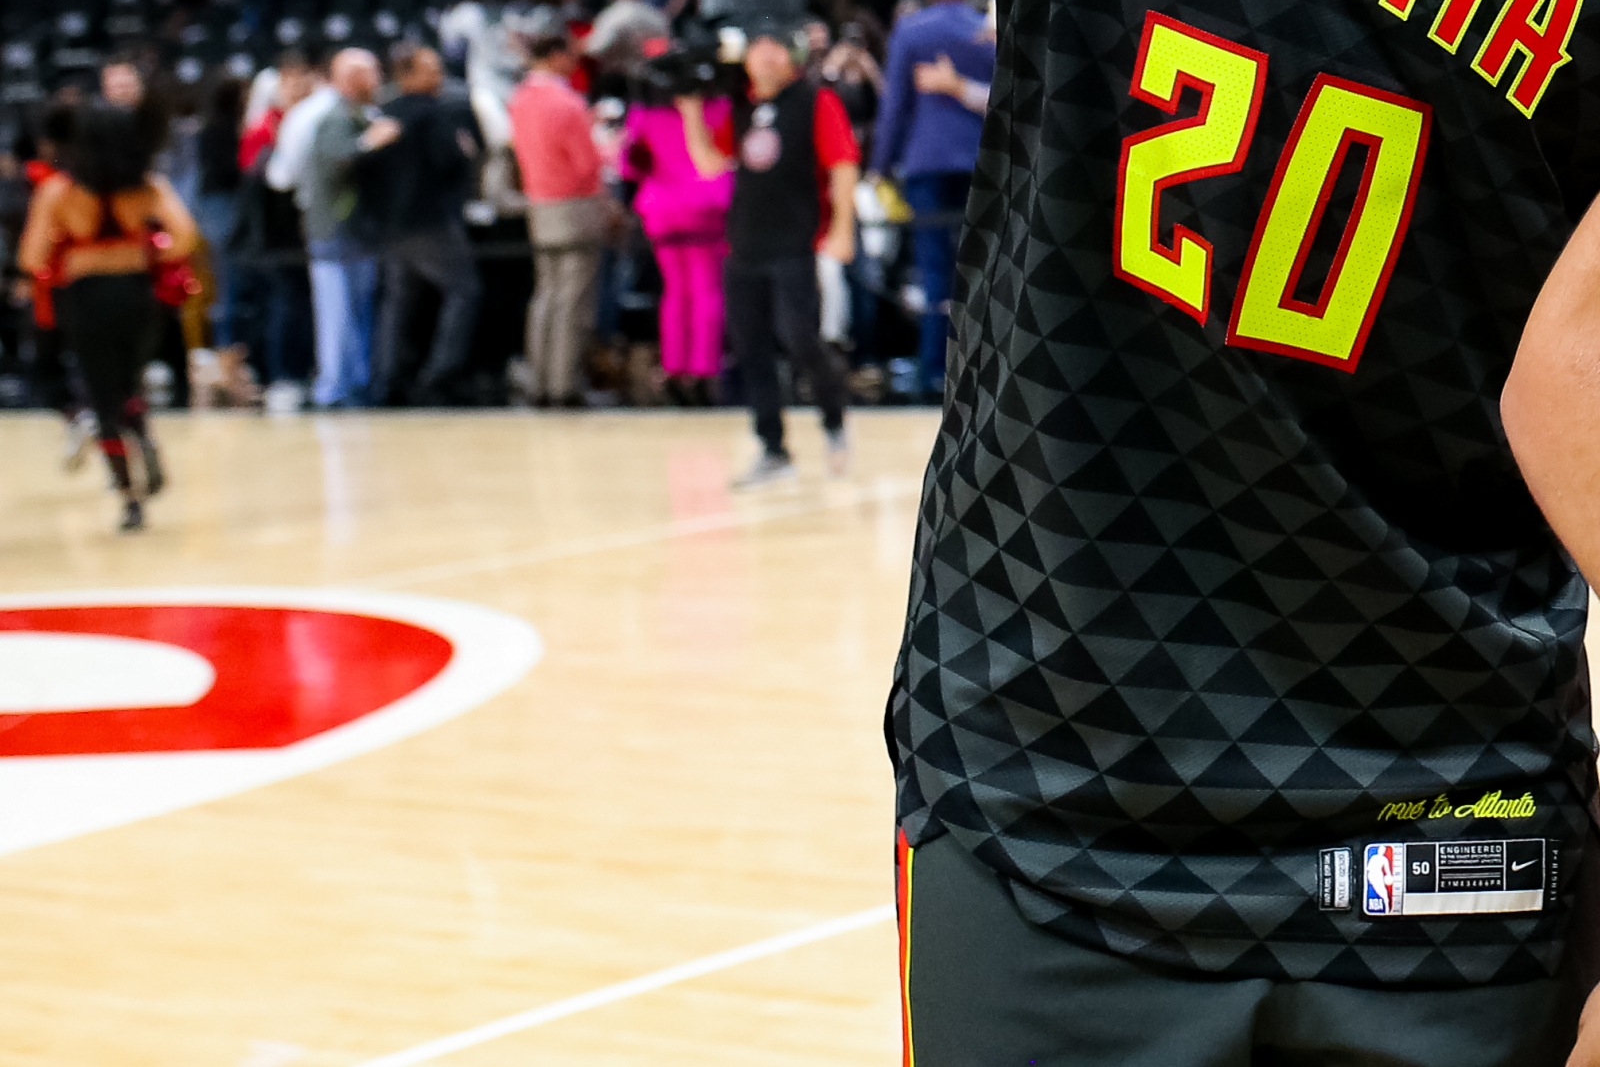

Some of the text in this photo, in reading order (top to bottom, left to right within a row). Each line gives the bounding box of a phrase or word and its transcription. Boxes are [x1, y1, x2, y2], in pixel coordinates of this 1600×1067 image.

[1113, 10, 1432, 373] 20
[1428, 793, 1452, 819] to
[1454, 790, 1537, 819] Atlanta
[1440, 845, 1502, 854] ENGINEERED
[1412, 861, 1430, 875] 50
